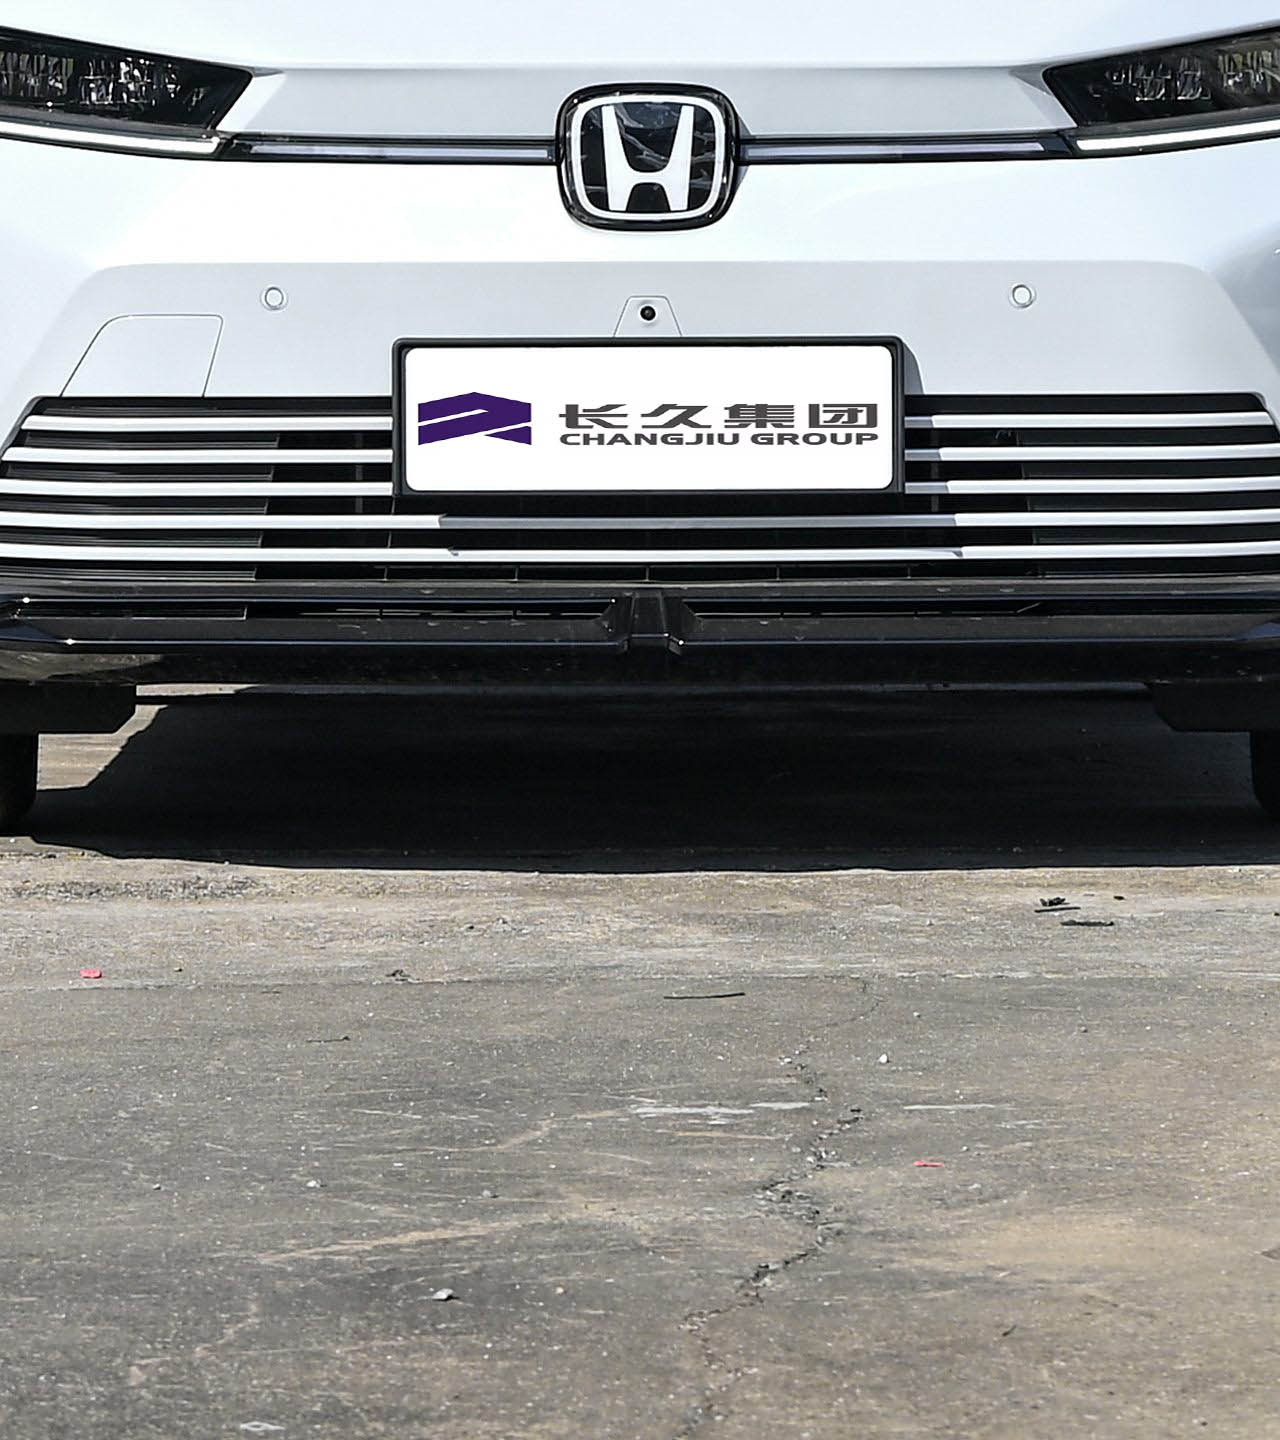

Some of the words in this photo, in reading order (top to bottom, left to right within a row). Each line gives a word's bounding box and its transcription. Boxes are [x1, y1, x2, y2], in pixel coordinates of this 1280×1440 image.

[558, 403, 878, 429] 长久集团
[559, 433, 740, 446] CHANGJIU
[750, 433, 879, 446] GROUP
